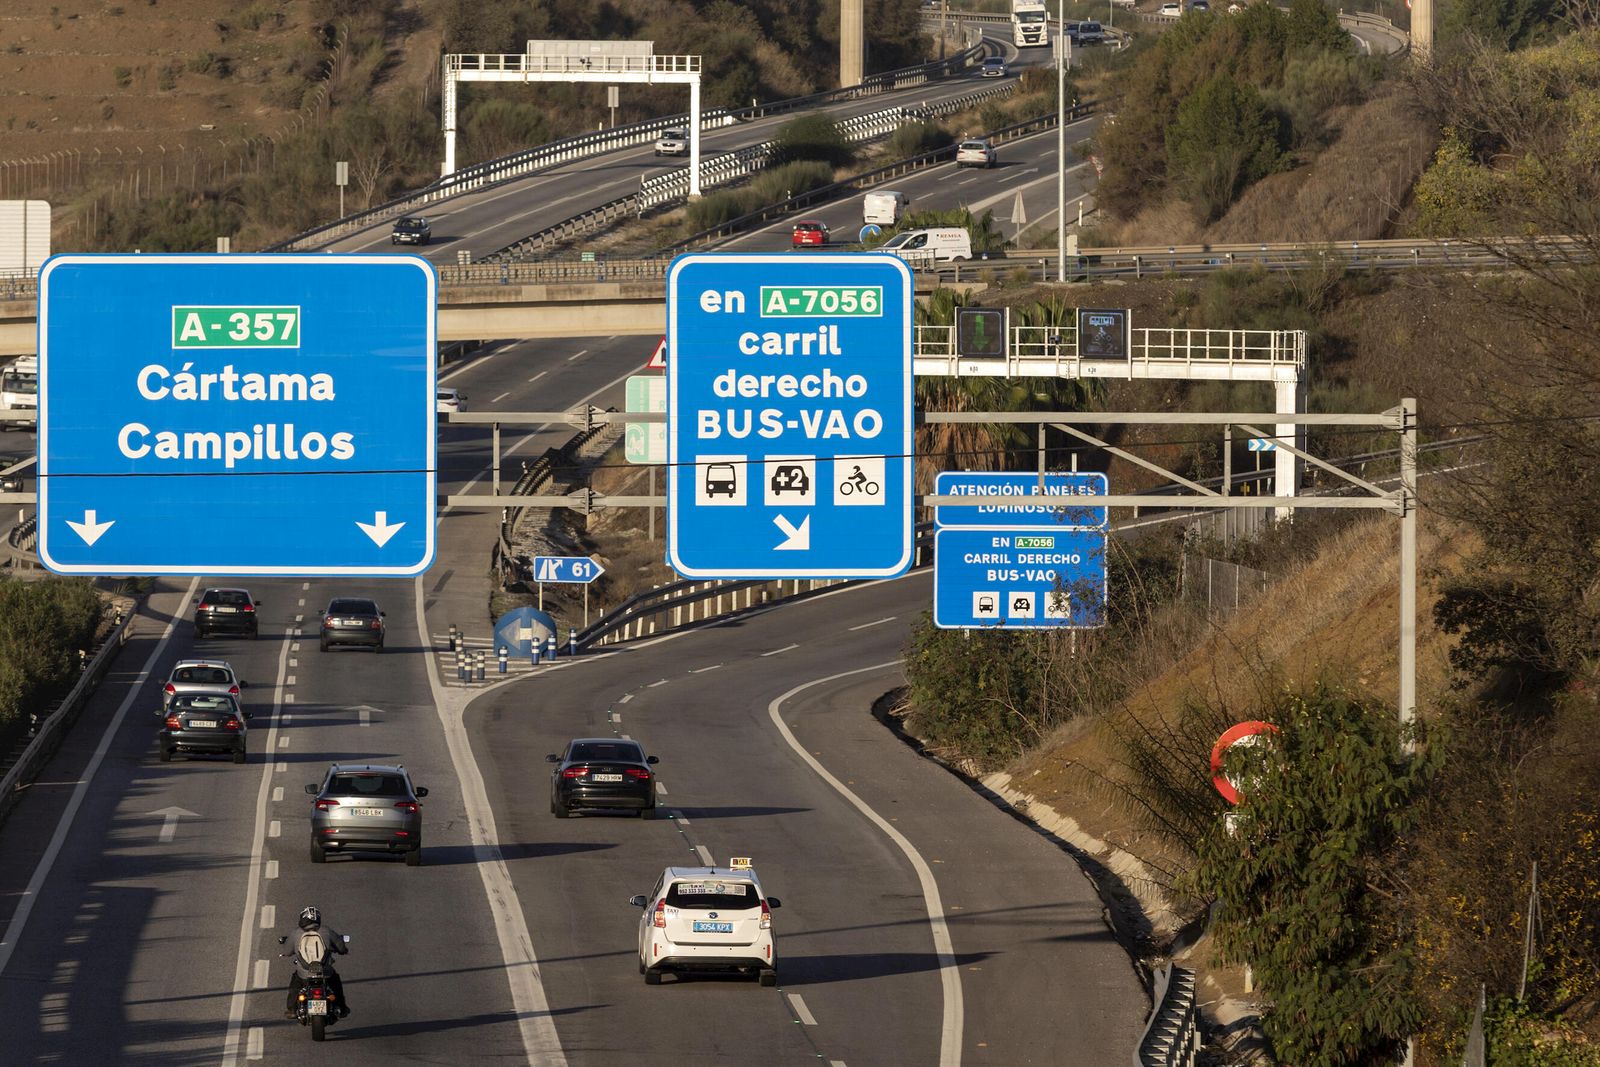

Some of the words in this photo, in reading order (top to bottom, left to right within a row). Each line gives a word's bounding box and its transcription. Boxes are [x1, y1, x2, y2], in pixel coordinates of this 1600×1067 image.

[700, 289, 745, 313] en
[766, 290, 878, 313] A-7056
[738, 325, 842, 355] carril
[137, 362, 336, 401] Cártama
[713, 369, 868, 398] derecho
[698, 409, 883, 439] BUS-VAO
[118, 422, 355, 469] Campillos
[949, 482, 1024, 496] ATENCIÓN
[992, 537, 1010, 547] EN
[1017, 539, 1053, 547] A-7056
[572, 562, 590, 577] 61
[964, 554, 1011, 564] CARRIL
[1018, 554, 1080, 564] DERECHO
[987, 570, 1056, 581] BUS-VAO
